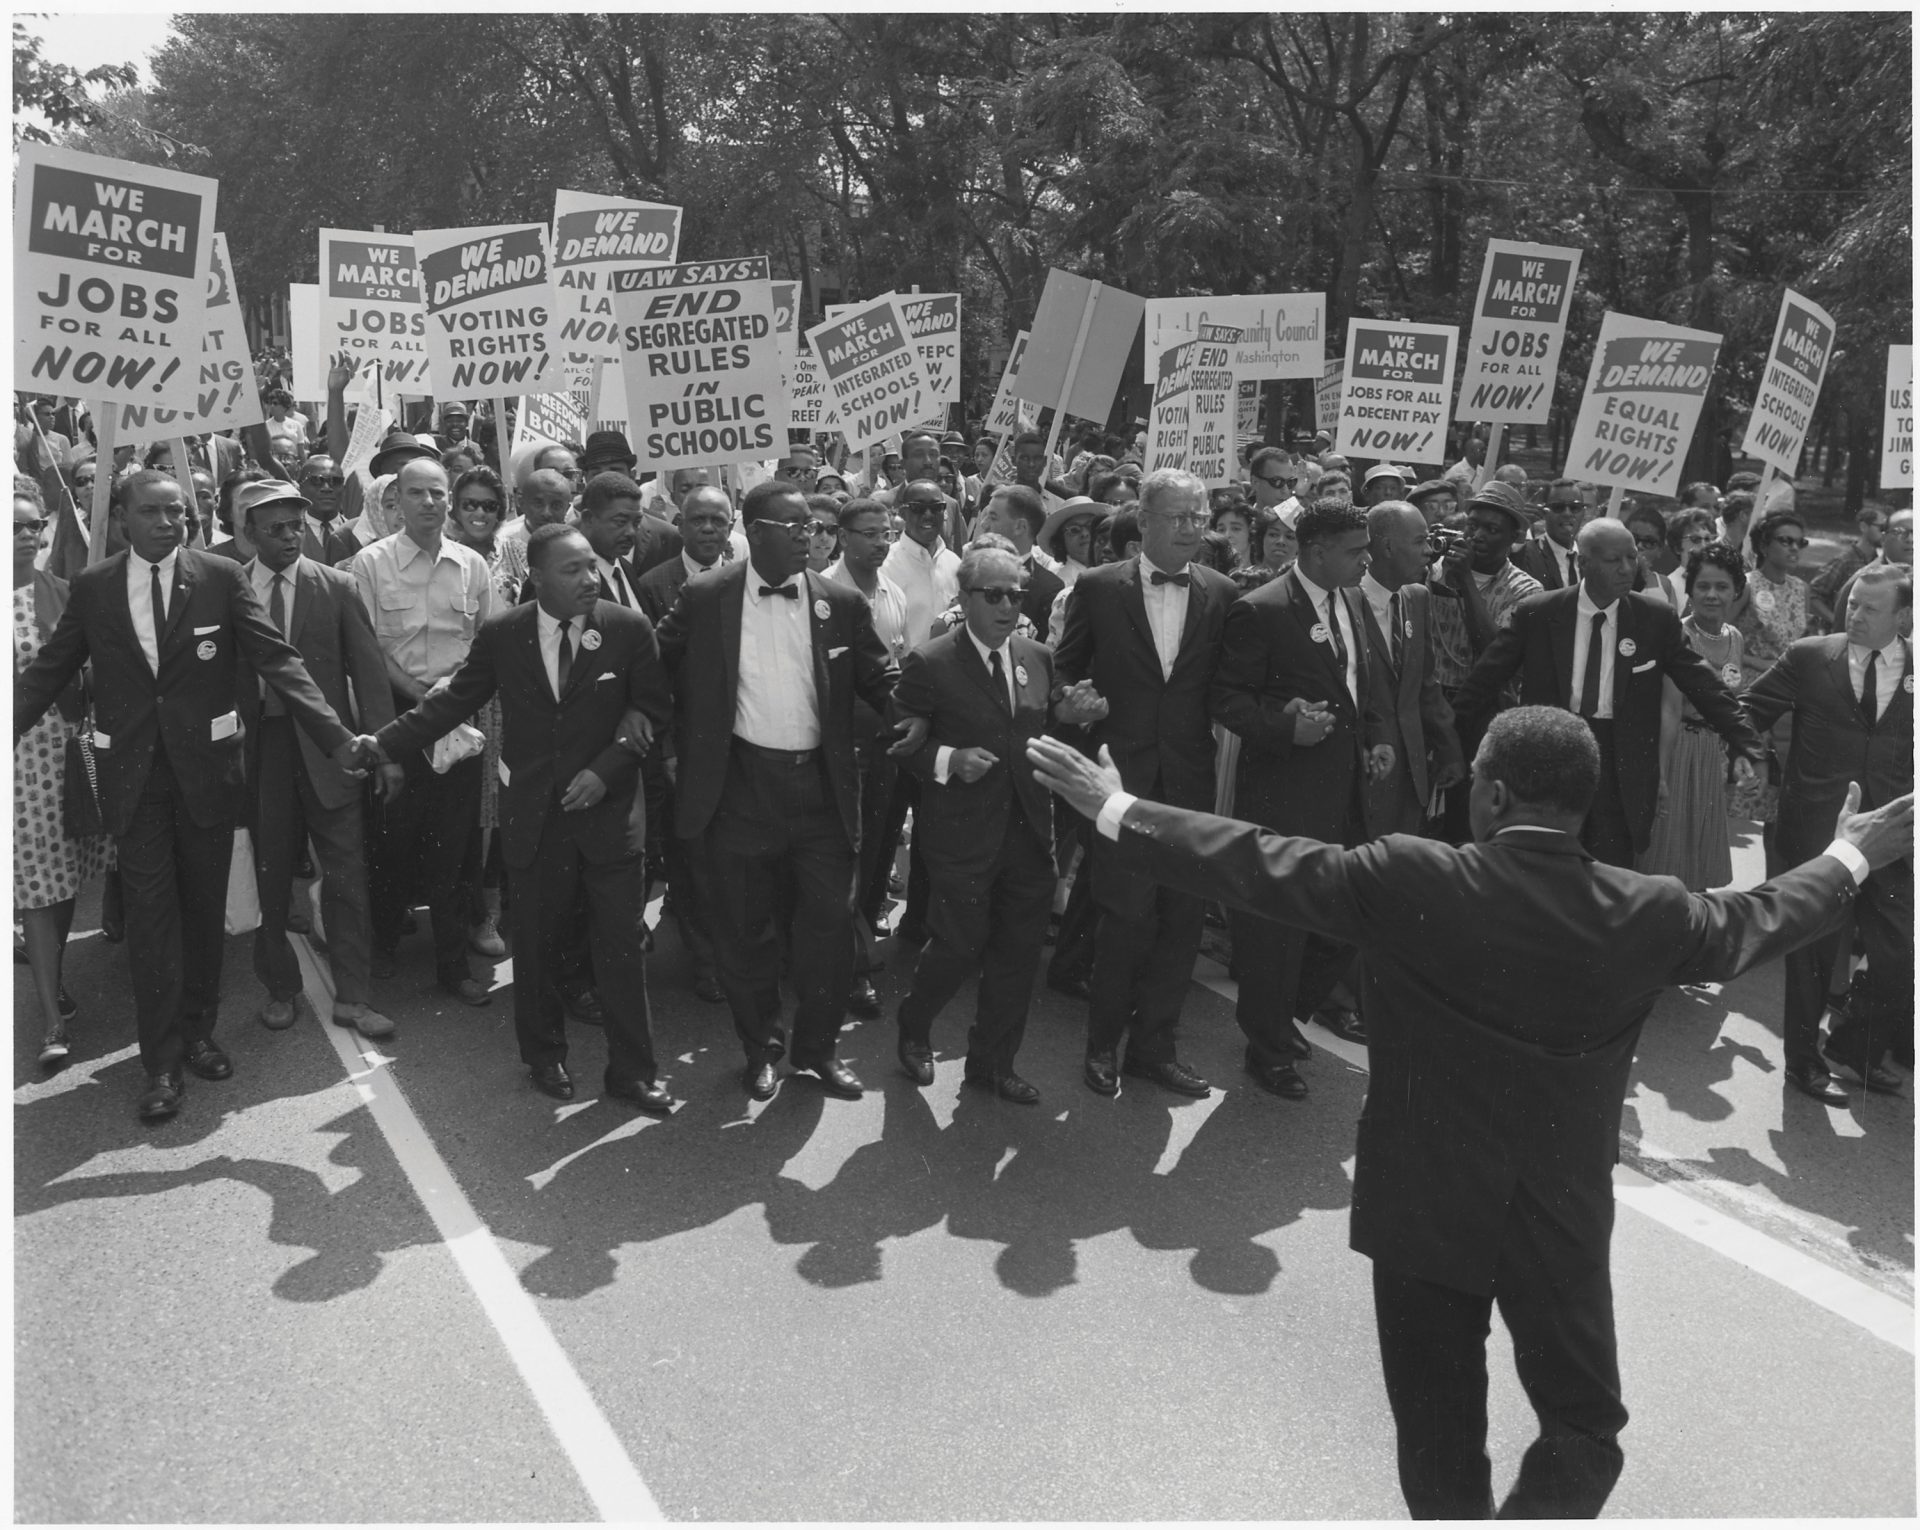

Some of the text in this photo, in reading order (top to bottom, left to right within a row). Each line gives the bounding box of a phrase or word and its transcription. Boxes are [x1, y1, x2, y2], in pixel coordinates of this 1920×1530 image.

[95, 182, 144, 212] WE
[43, 202, 186, 252] MARCH
[594, 211, 639, 233] WE
[87, 243, 142, 264] FOR
[368, 247, 399, 264] WE
[461, 238, 503, 270] WE
[561, 232, 668, 260] DEMAND
[434, 254, 541, 305] DEMAND
[559, 270, 596, 290] AN
[621, 268, 677, 290] UAW
[683, 260, 763, 284] SAYS:
[1521, 260, 1545, 279] WE
[38, 273, 178, 323] JOBS
[366, 287, 401, 299] FOR
[1491, 279, 1561, 305] MARCH
[580, 294, 612, 316] LA
[644, 289, 741, 320] END
[906, 301, 933, 320] WE
[1510, 306, 1536, 318] FOR
[337, 309, 425, 336] JOBS
[438, 306, 548, 333] VOTING
[840, 317, 867, 338] WE
[908, 312, 954, 334] MAND
[1276, 307, 1319, 341] Council
[1805, 317, 1820, 340] WE
[40, 315, 171, 347] FOR ALL
[625, 314, 769, 351] SEGREGATED
[340, 337, 423, 351] FOR ALL
[450, 332, 546, 358] RIGHTS
[827, 321, 895, 365] MARCH
[917, 345, 955, 358] FEPC
[1388, 335, 1416, 350] WE
[1482, 330, 1550, 359] JOBS
[1639, 340, 1685, 363] WE
[1782, 328, 1824, 368] MARCH
[648, 344, 750, 377] RULES
[800, 361, 817, 371] One
[851, 348, 879, 367] FOR
[1175, 344, 1195, 368] WE
[1199, 348, 1228, 367] END
[1359, 349, 1439, 370] MARCH
[1793, 357, 1809, 374] FOR
[31, 346, 181, 393] NOW!
[452, 352, 550, 388] NOW!
[833, 351, 912, 398] INTEGRATED
[1382, 369, 1413, 379] FOR
[1481, 362, 1541, 375] FOR ALL
[1602, 364, 1707, 388] DEMAND
[573, 376, 592, 386] FO
[683, 381, 720, 397] IN
[792, 384, 820, 399] PEAK
[1191, 370, 1232, 391] SEGREGATED
[1768, 366, 1815, 408] INTEGRATED
[807, 399, 822, 408] FO
[841, 371, 920, 416] SCHOOLS
[1195, 394, 1225, 414] RULES
[1319, 391, 1341, 402] AN EN
[1347, 386, 1442, 404] JOBS FOR ALL
[1470, 382, 1544, 410] NOW!
[1890, 390, 1912, 409] U.S.
[540, 405, 555, 419] WE
[649, 394, 765, 428] PUBLIC
[856, 390, 921, 439] NOW!
[1157, 407, 1189, 424] VOTIN
[1320, 402, 1330, 411] TO
[1343, 405, 1440, 424] A DECENT PAY
[1604, 396, 1680, 431] EQUAL
[1761, 393, 1806, 432] SCHOOLS
[1203, 421, 1214, 432] IN
[1595, 420, 1678, 455] RIGHTS
[647, 423, 773, 459] SCHOOLS
[1157, 430, 1188, 447] RIGHT
[1193, 434, 1225, 456] PUBLIC
[1350, 428, 1434, 452] NOW!
[1755, 422, 1799, 460] NOW!
[1190, 458, 1225, 478] SCHOOLS
[1585, 447, 1674, 484] NOW!
